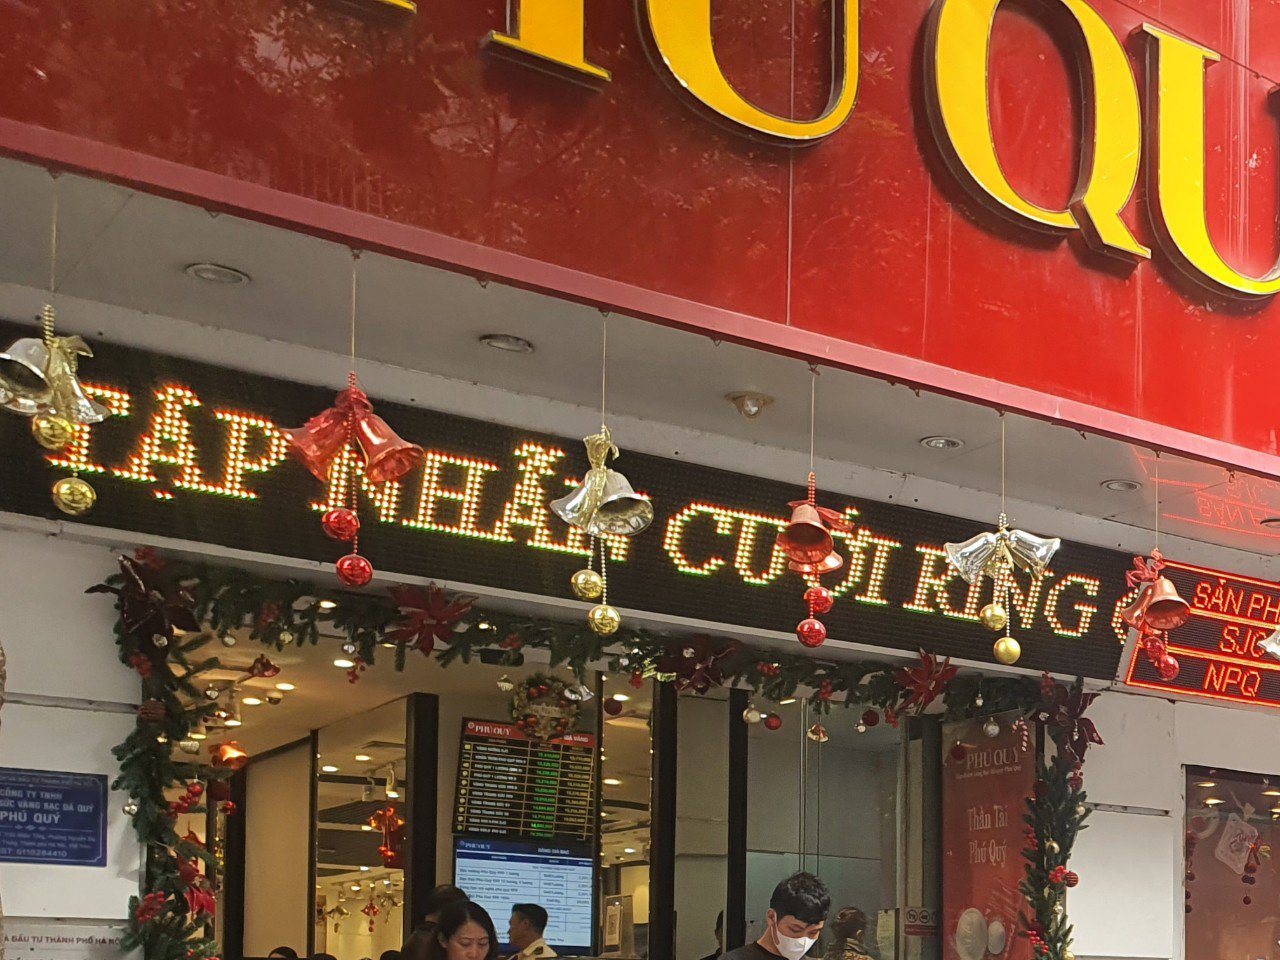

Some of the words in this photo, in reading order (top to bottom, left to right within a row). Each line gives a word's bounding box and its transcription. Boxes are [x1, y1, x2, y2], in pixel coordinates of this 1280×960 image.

[1194, 578, 1244, 615] SẢN
[1220, 625, 1267, 657] SJC
[1204, 662, 1260, 697] NPQ
